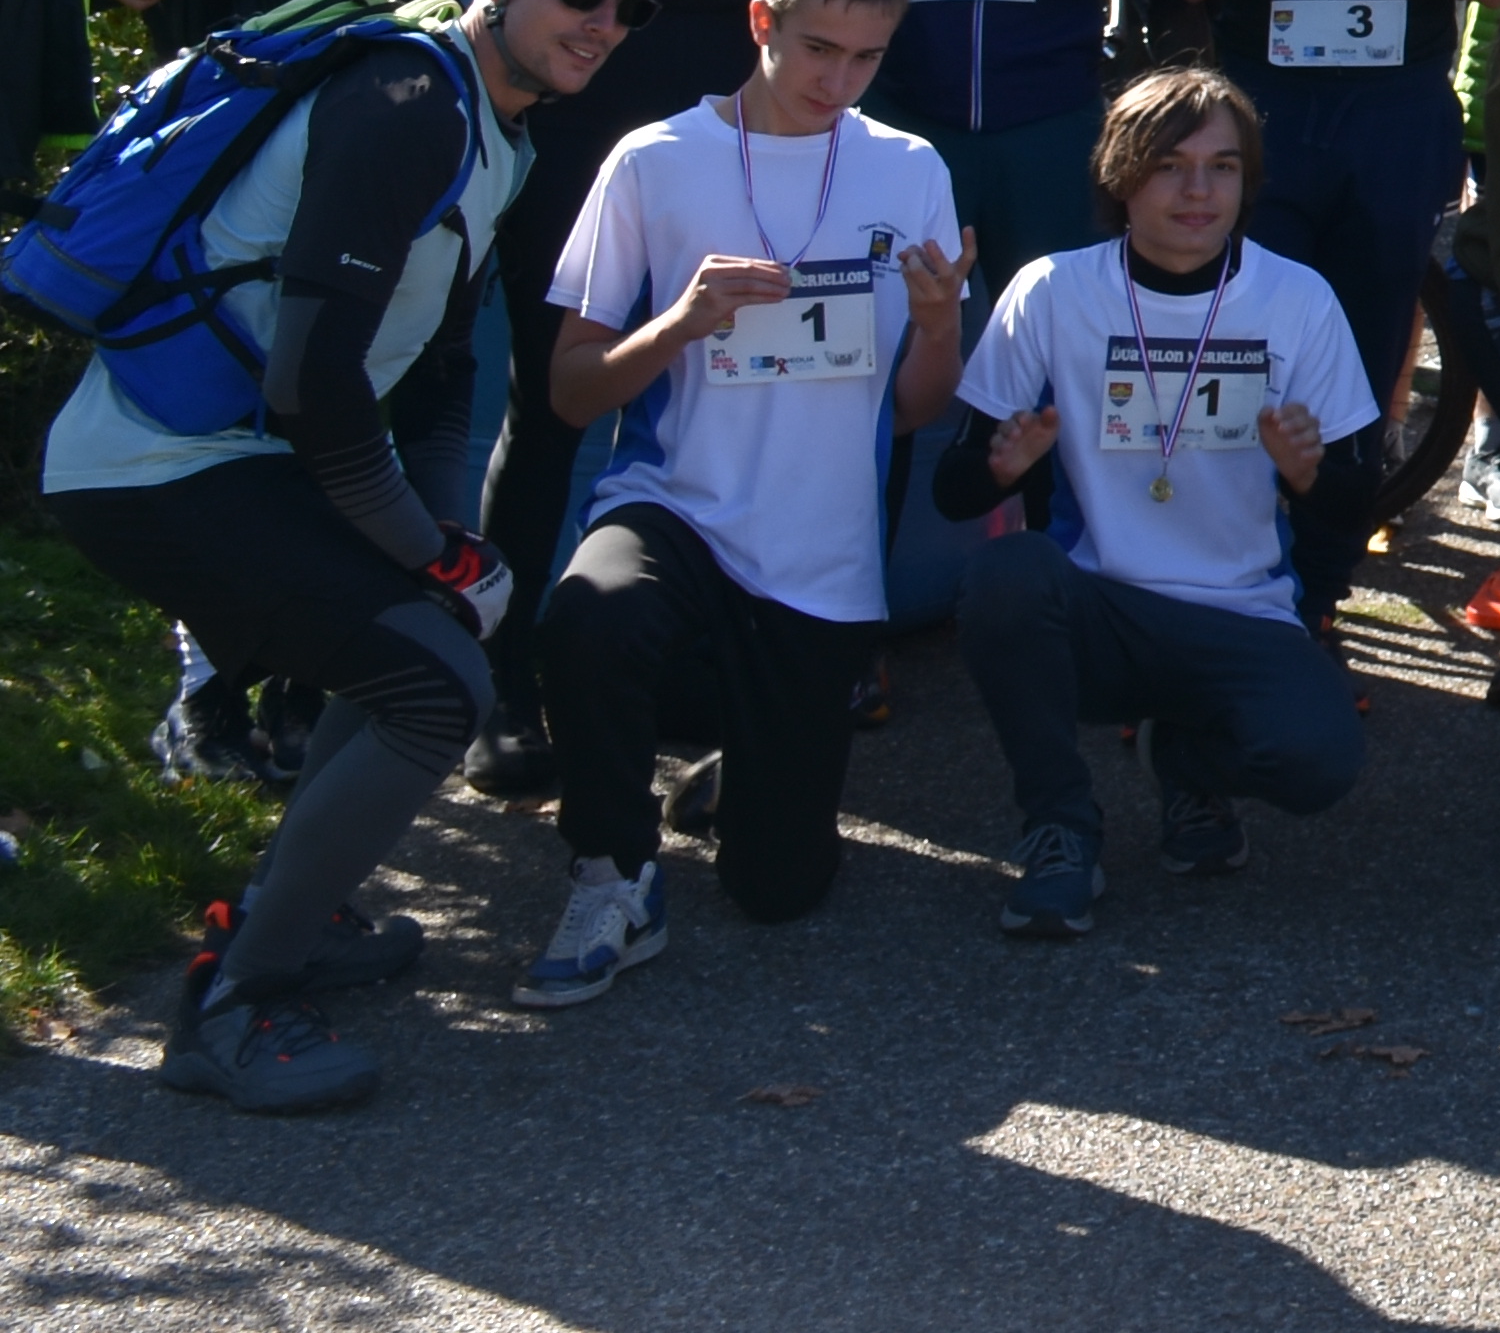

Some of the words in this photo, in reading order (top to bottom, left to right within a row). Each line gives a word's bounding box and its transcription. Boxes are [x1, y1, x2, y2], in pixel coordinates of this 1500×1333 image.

[1346, 4, 1374, 39] 3
[801, 301, 826, 343] 1
[1196, 378, 1221, 417] 1
